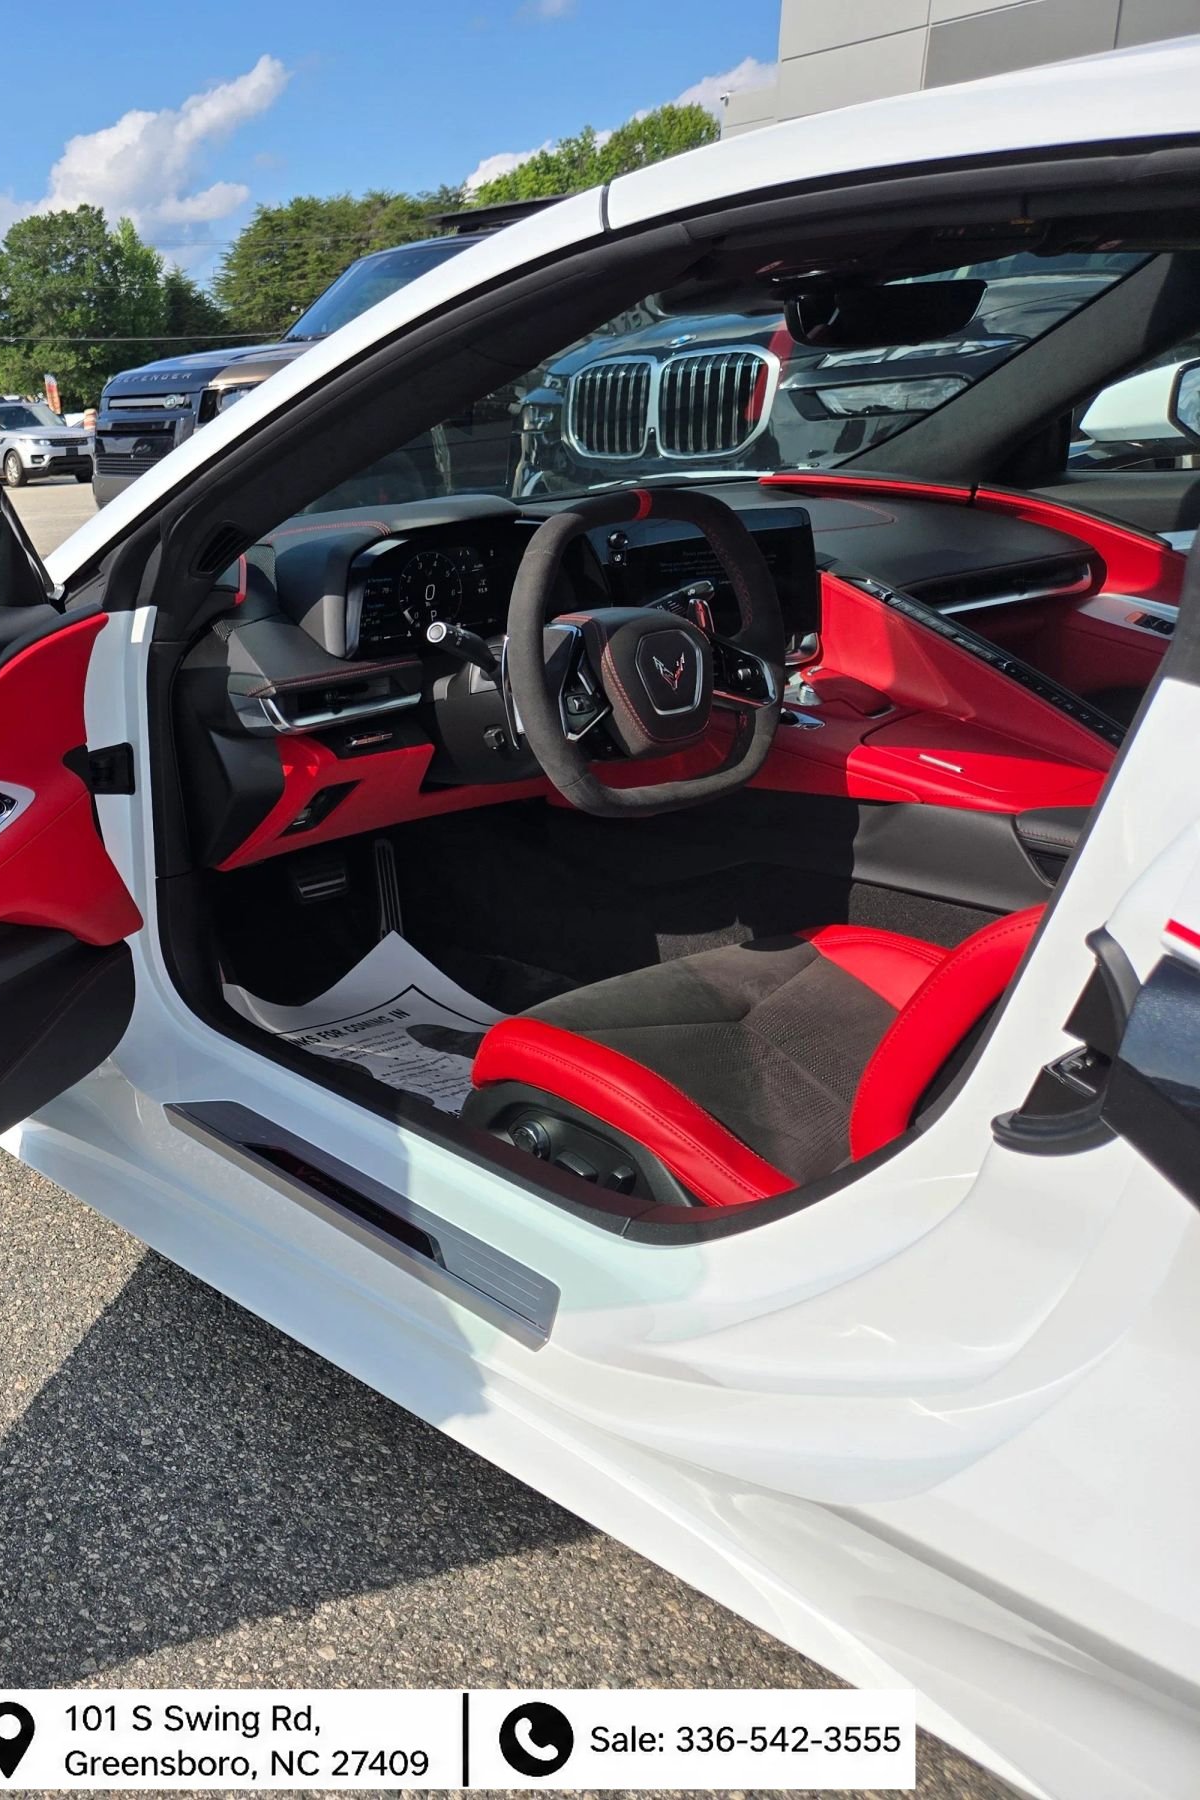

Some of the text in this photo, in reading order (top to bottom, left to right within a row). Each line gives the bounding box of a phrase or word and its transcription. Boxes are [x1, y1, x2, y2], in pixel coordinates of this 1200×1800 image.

[114, 372, 193, 384] DEFENDER
[425, 584, 435, 600] 0
[430, 610, 437, 621] P
[315, 1029, 349, 1040] FOR
[343, 1015, 395, 1033] COMING
[387, 1008, 411, 1020] IN
